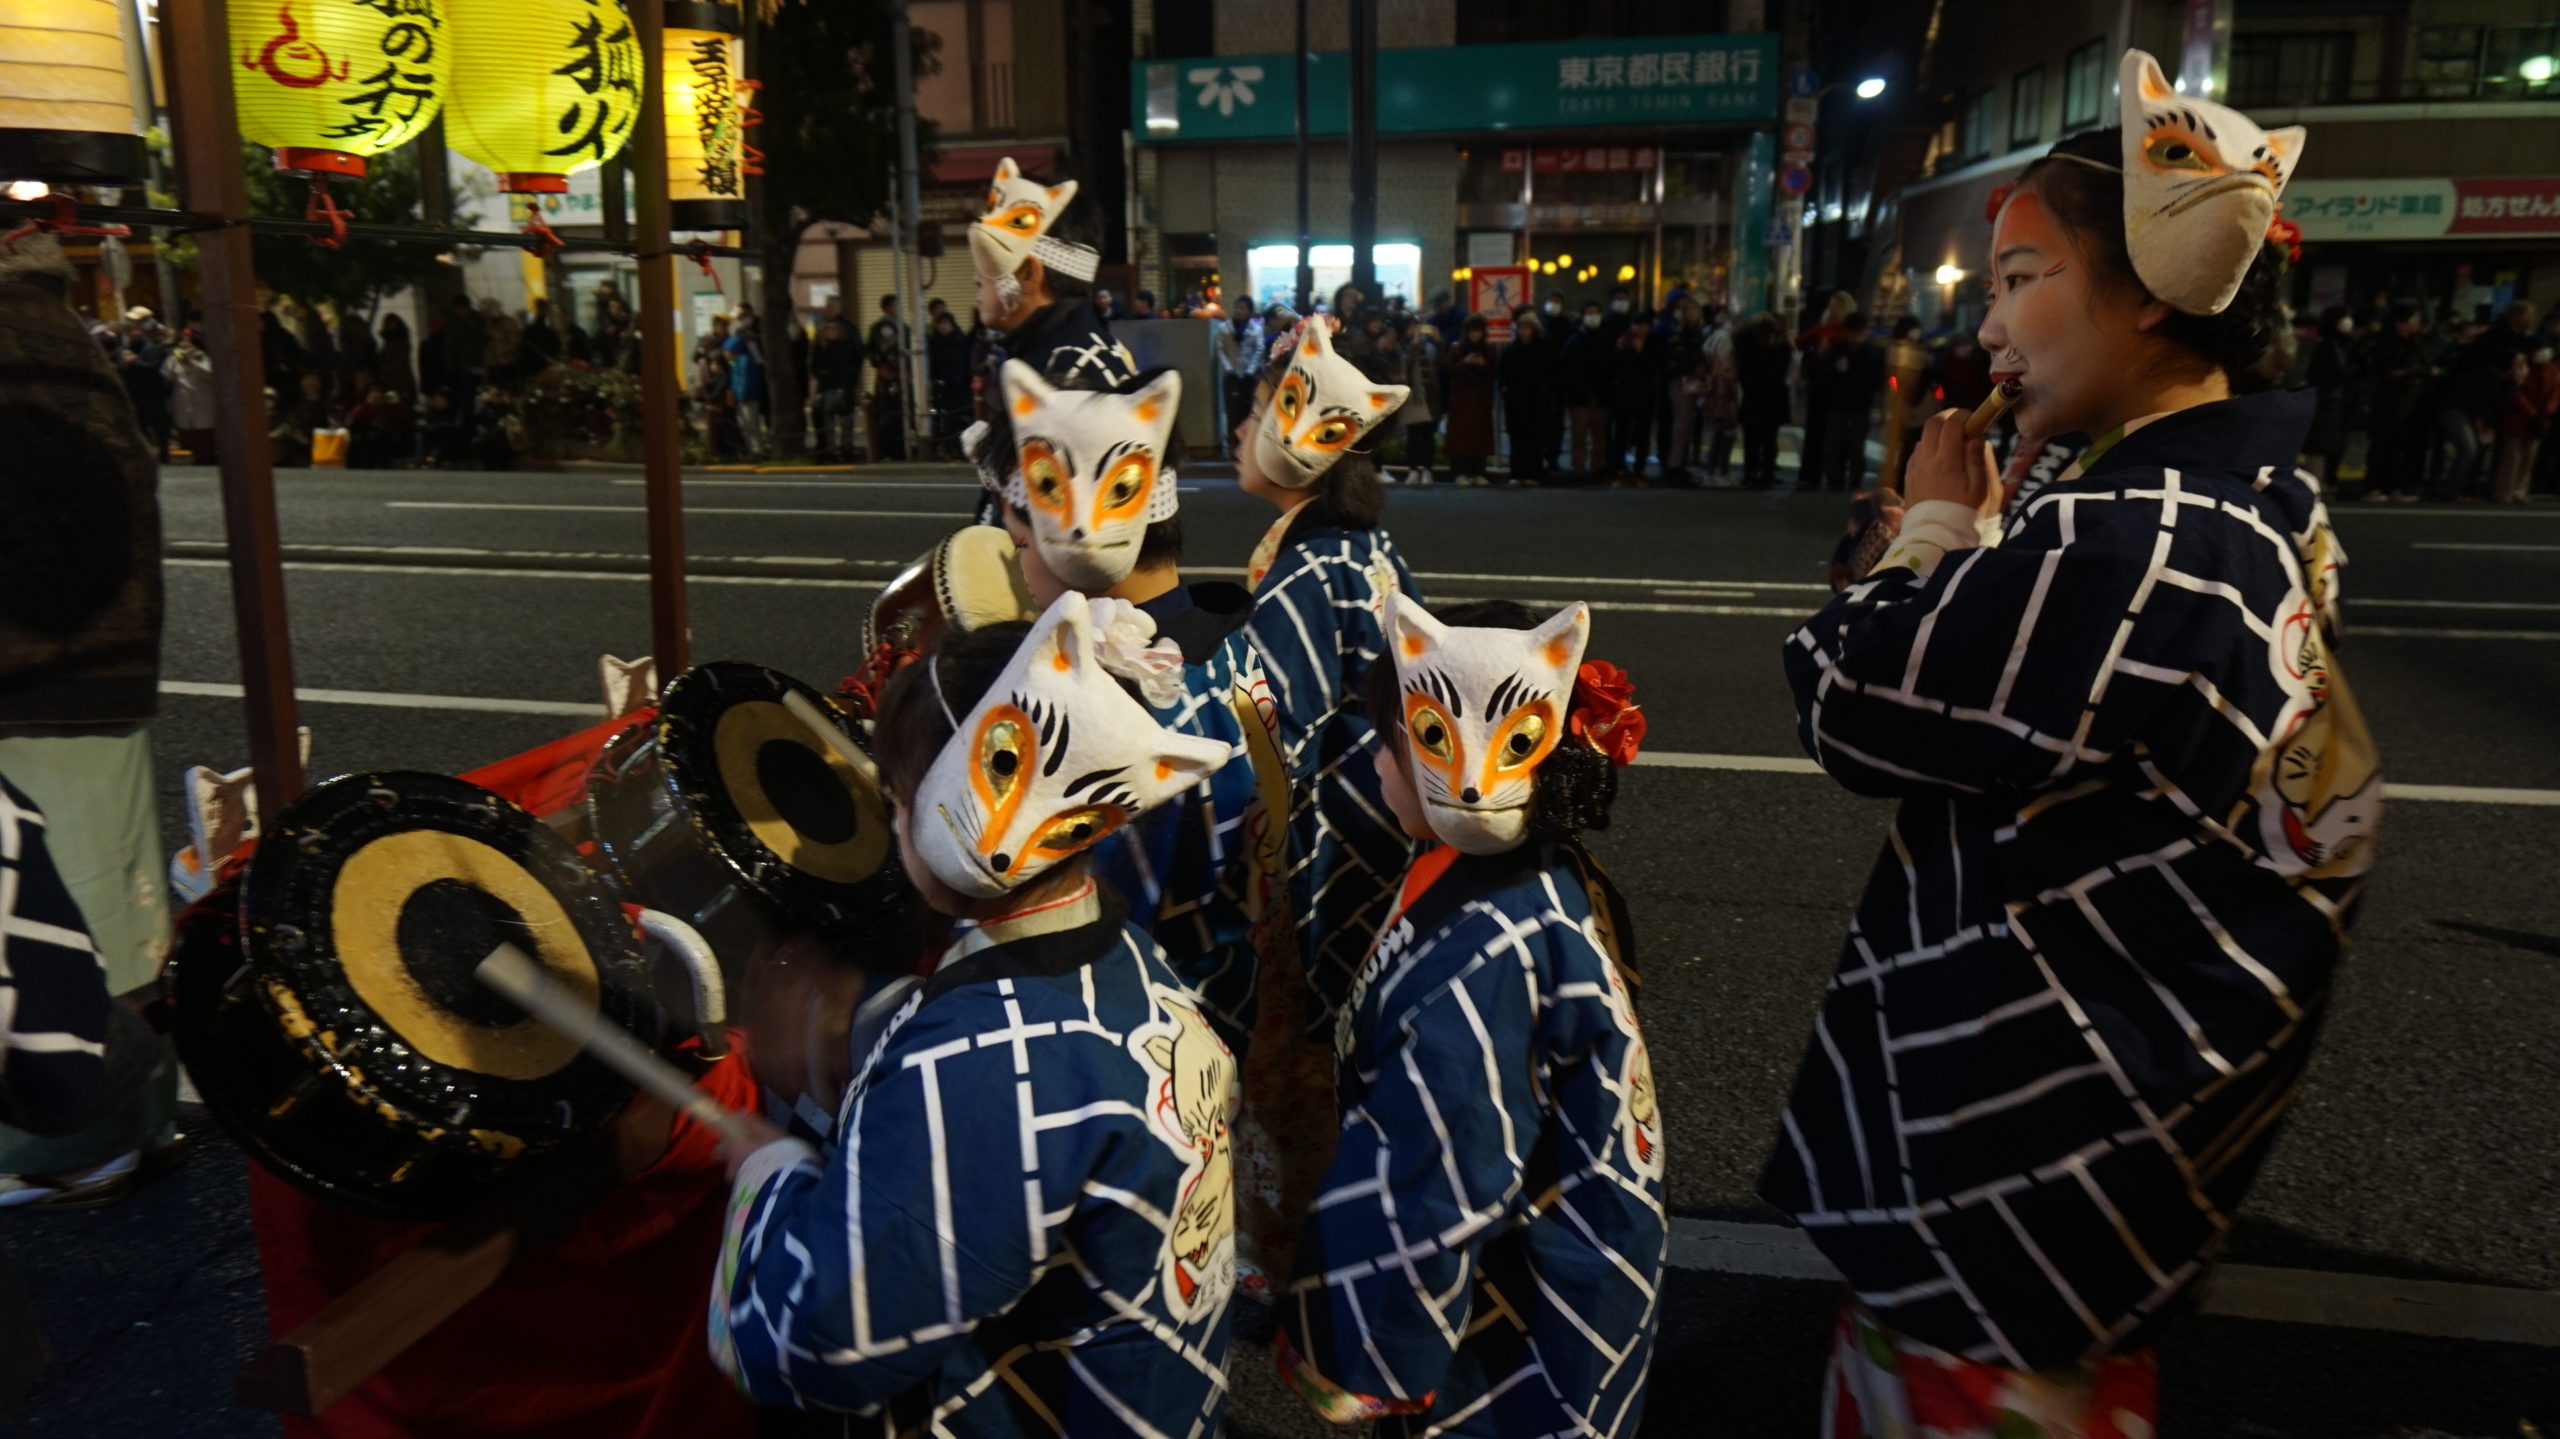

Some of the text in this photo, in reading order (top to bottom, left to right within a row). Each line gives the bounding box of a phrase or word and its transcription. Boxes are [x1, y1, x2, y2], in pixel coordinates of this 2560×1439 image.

[541, 0, 640, 160] 狐火
[1558, 49, 1762, 89] 東京都民銀行
[1558, 90, 1759, 112] TOKYO TOMIN BANK
[2292, 195, 2442, 217] アイランド薬局
